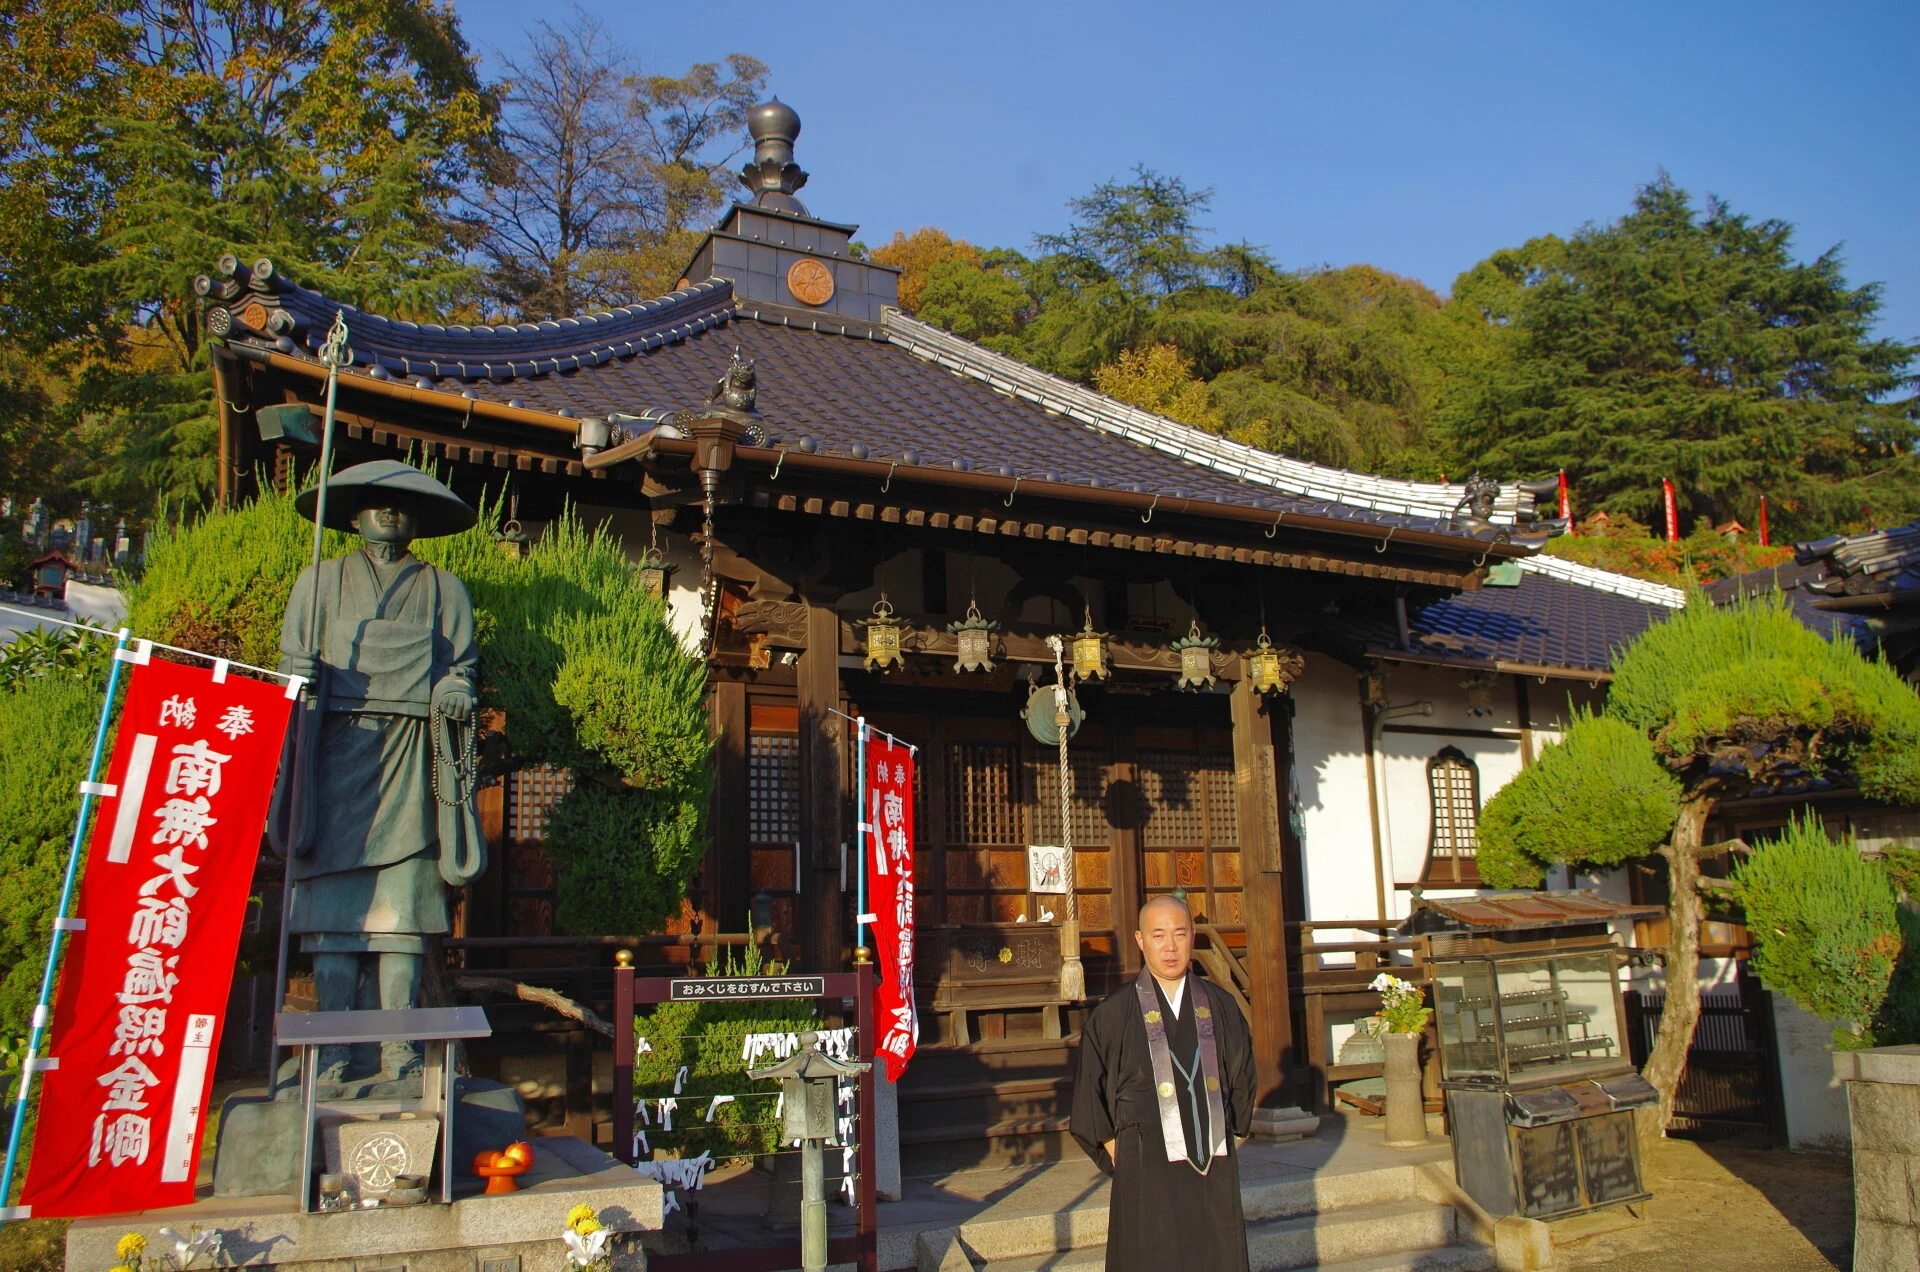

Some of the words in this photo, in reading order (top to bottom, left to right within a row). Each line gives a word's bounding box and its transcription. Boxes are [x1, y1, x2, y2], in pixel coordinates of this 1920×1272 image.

[682, 981, 814, 995] おみくじをむすんで下さい
